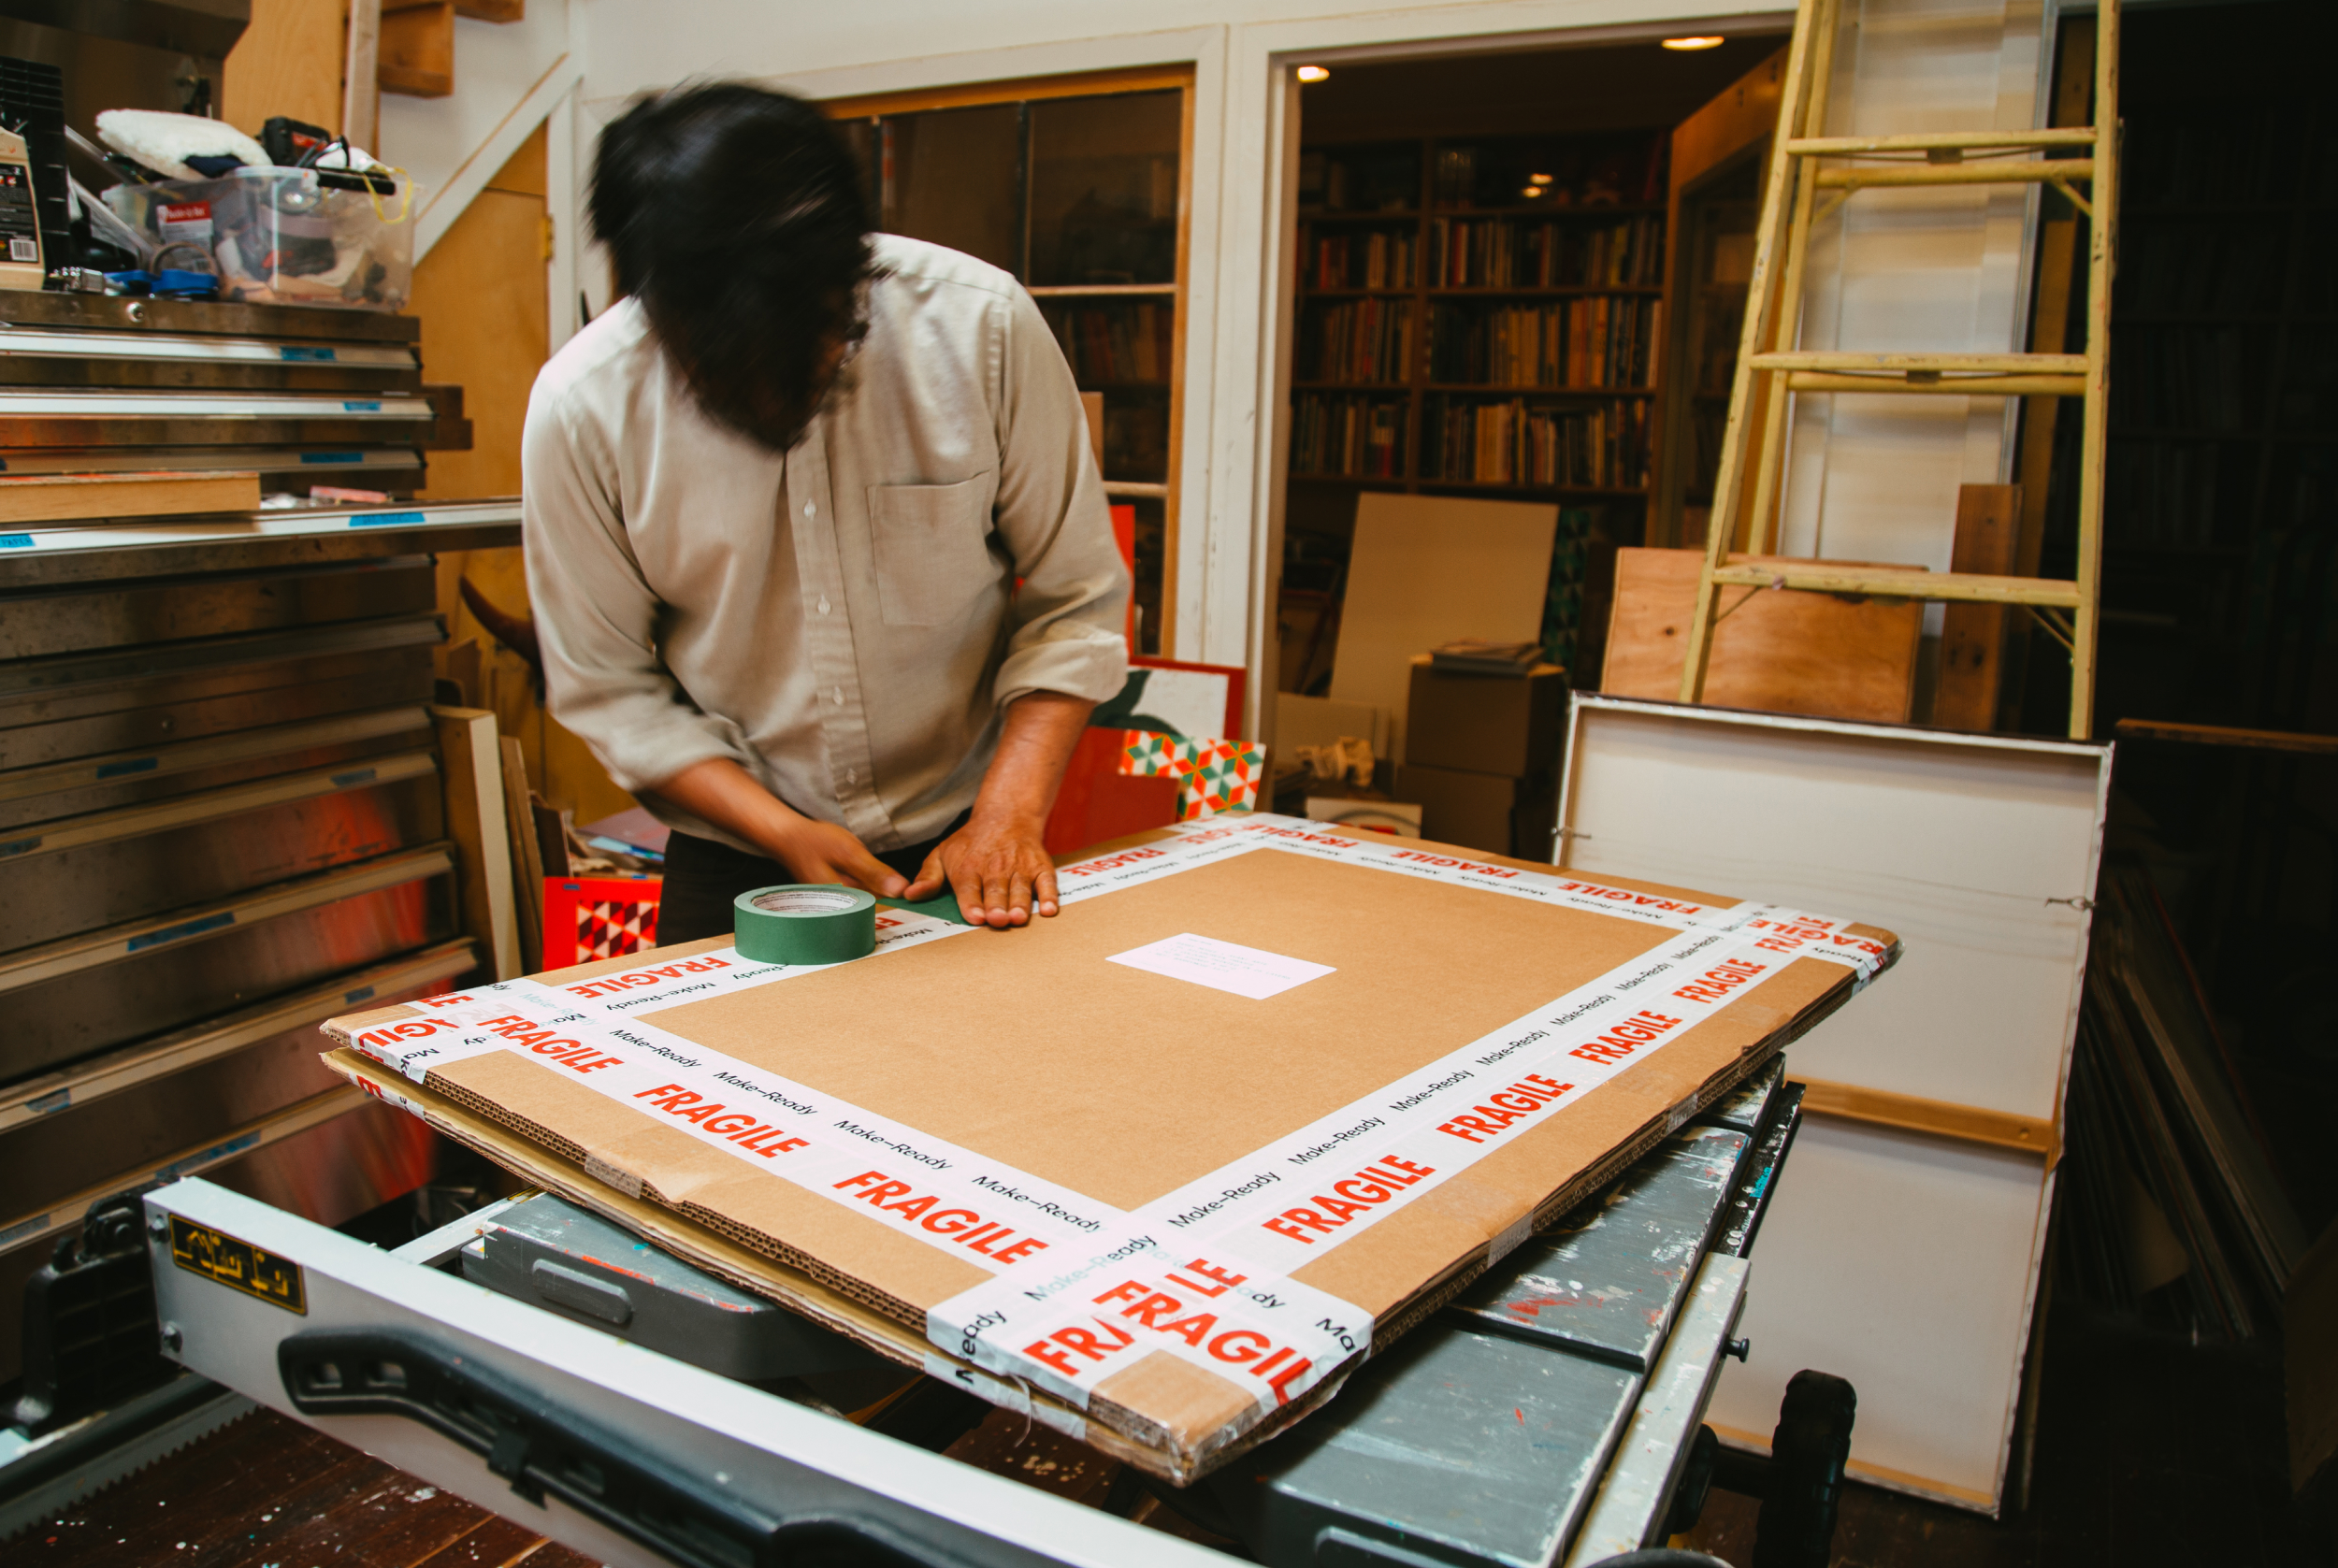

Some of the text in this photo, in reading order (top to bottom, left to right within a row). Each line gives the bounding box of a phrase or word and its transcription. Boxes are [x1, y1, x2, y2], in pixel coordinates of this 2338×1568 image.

[1061, 847, 1169, 877] FRAGILE
[1390, 850, 1521, 879] FRAGILE
[1558, 882, 1702, 914] FRAGILE
[1566, 897, 1663, 919] Make-Ready
[566, 957, 732, 1000] FRAGILE
[607, 982, 716, 1012] Make-Ready
[1168, 1171, 1281, 1228] Make-Ready
[1288, 1116, 1386, 1165] Make-Ready
[1389, 1069, 1475, 1112] Make-Ready
[1475, 1029, 1551, 1067] Make-Ready
[1550, 993, 1616, 1027] Make-Ready
[1614, 962, 1674, 991] Make-Ready
[1670, 935, 1725, 960] Make-Ready
[1261, 1154, 1436, 1244] FRAGILE
[1435, 1072, 1575, 1144] FRAGILE
[1567, 1010, 1683, 1065] FRAGILE
[1672, 958, 1768, 1004] FRAGILE
[609, 1029, 702, 1068] Make-Ready
[714, 1072, 817, 1115] Make-Ready
[833, 1120, 953, 1170] Make-Ready
[972, 1175, 1102, 1232] Make-Ready
[477, 1014, 624, 1073] FRAGILE
[634, 1083, 810, 1158] FRAGILE
[833, 1171, 1049, 1264] FRAGILE
[1091, 1279, 1313, 1406] FRAGIL
